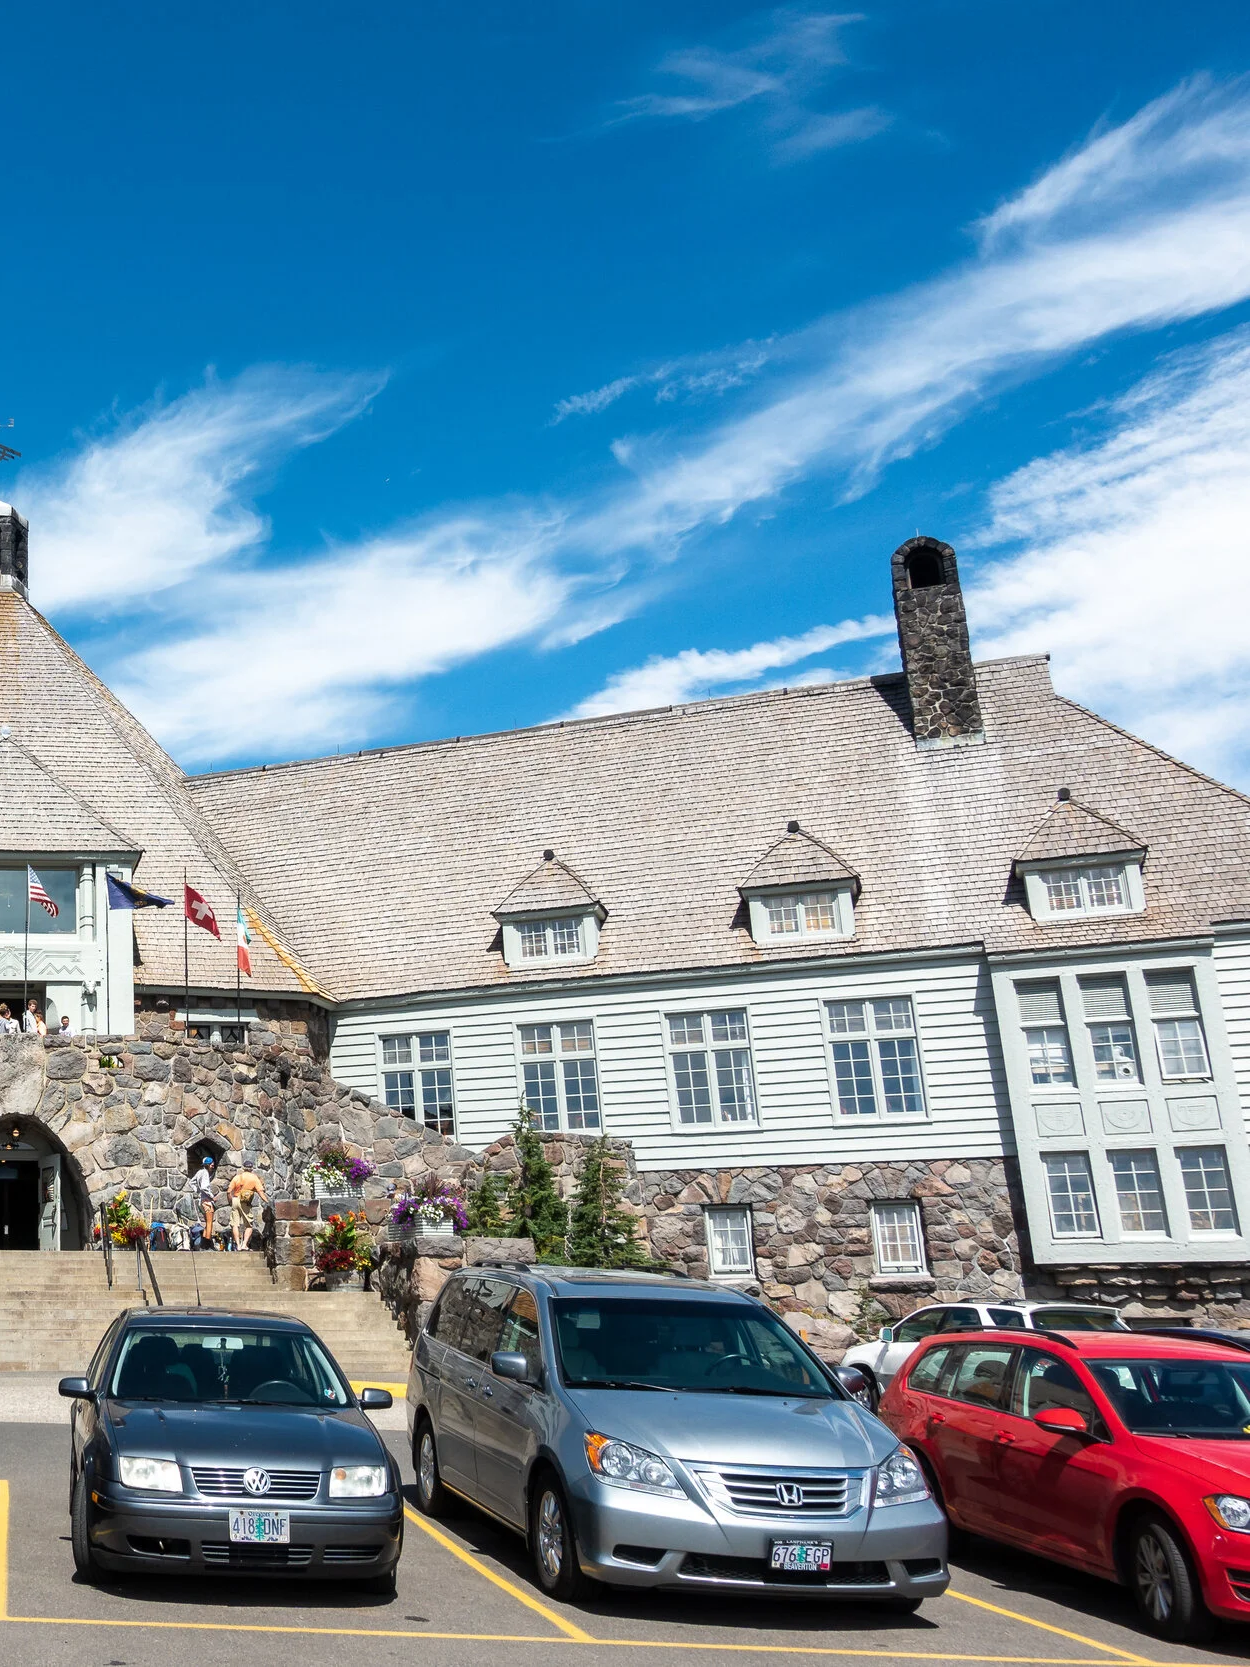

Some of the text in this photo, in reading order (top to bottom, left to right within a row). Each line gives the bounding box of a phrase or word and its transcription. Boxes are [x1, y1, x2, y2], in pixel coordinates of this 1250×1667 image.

[233, 1518, 287, 1536] 418 DNF
[773, 1547, 830, 1563] 676 EGP
[784, 1563, 817, 1571] BEAVERTON
